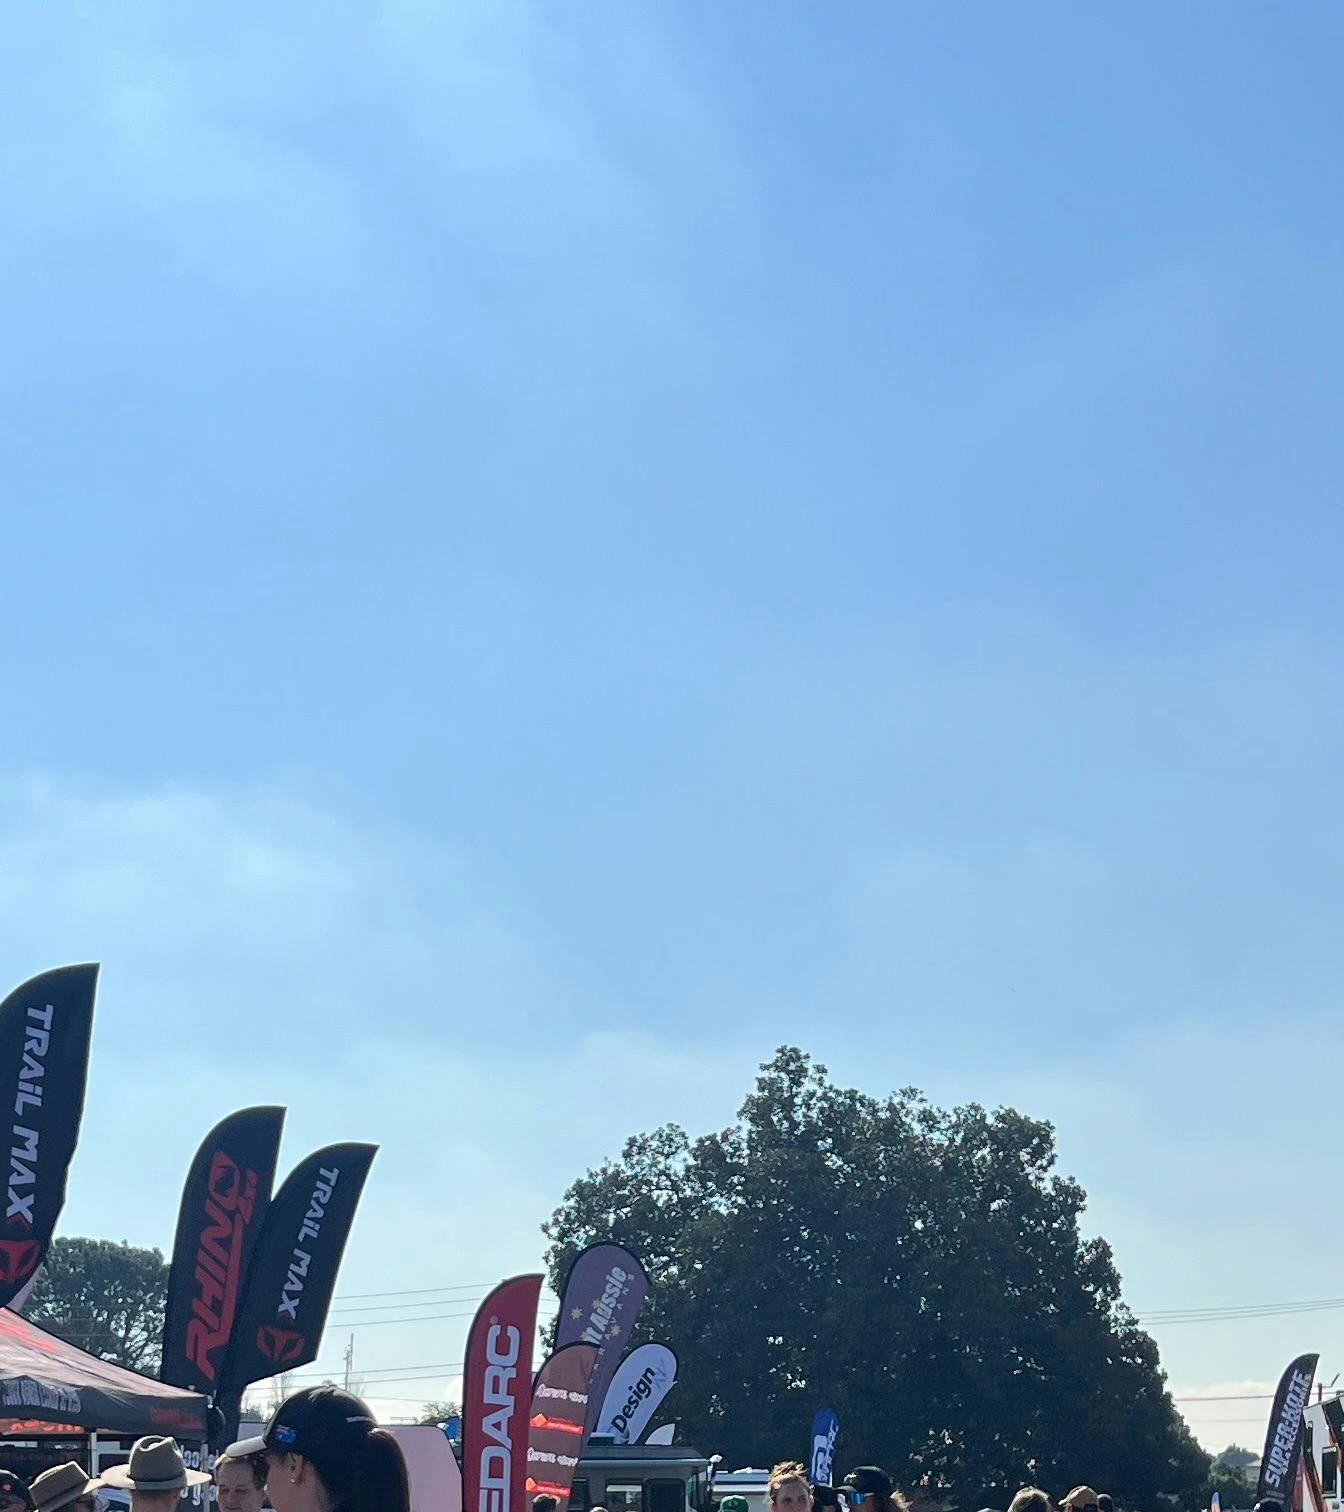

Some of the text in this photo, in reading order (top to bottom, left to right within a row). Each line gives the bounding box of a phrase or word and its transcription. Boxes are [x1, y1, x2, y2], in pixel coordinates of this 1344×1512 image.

[6, 1124, 39, 1225] MAX
[278, 1248, 311, 1320] MAX
[589, 1266, 627, 1332] Aussie
[611, 1367, 656, 1434] Design
